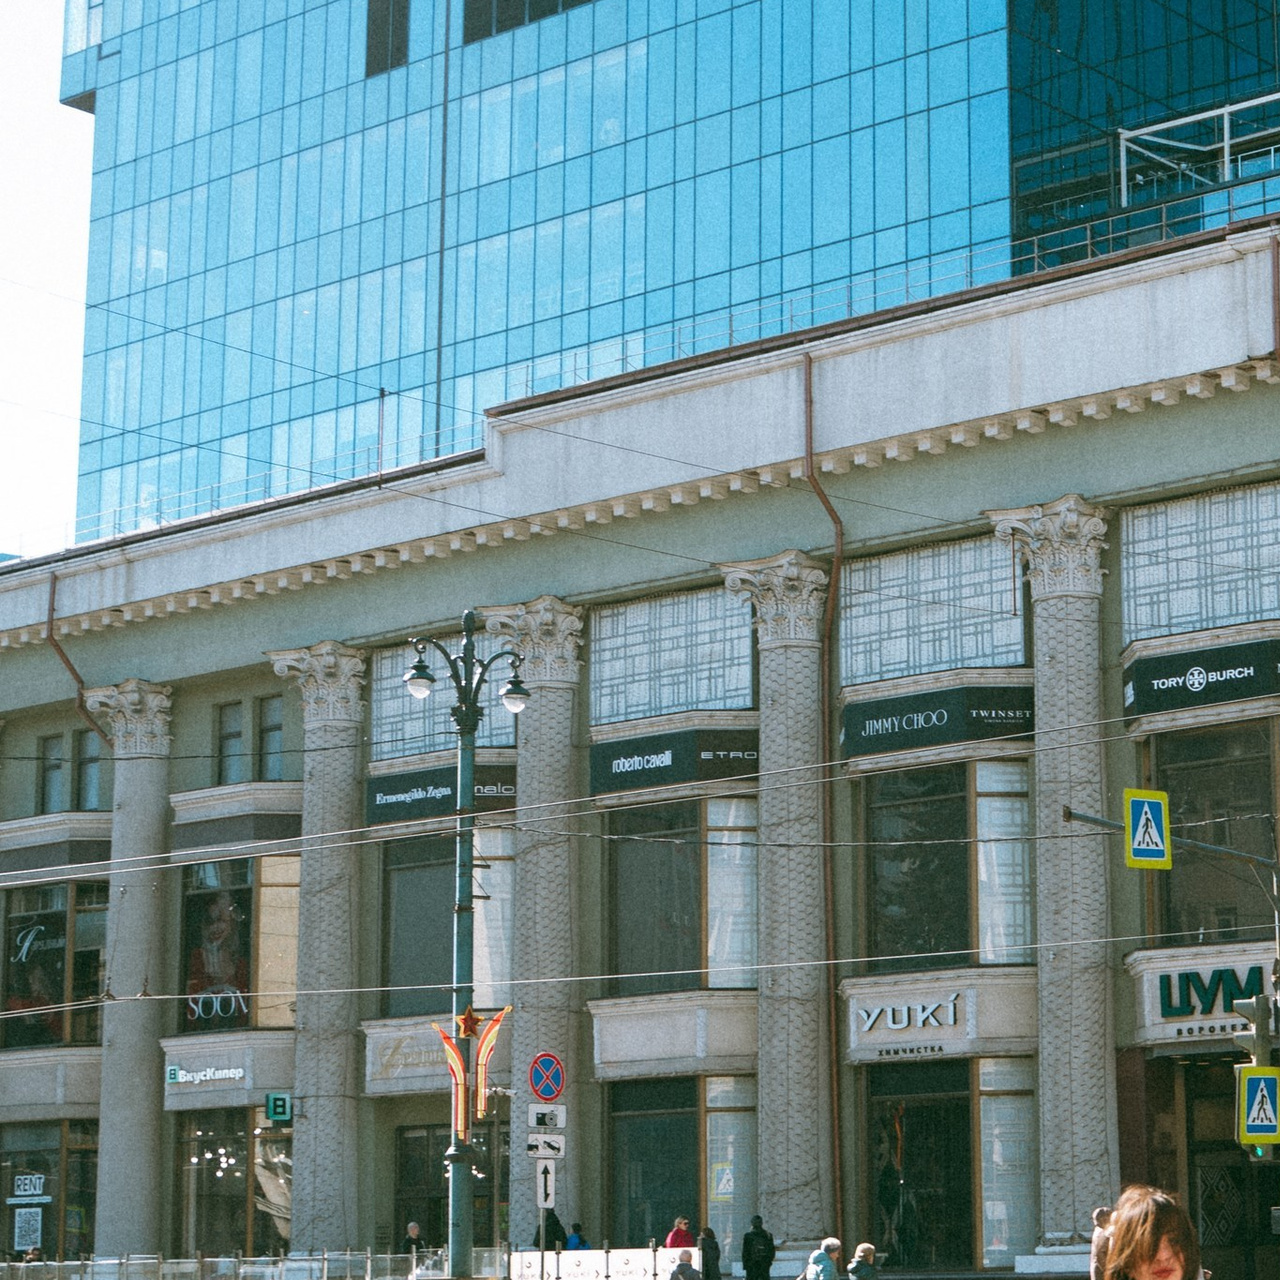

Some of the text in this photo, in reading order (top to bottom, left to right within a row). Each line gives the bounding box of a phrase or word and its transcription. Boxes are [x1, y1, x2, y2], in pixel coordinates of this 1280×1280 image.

[1151, 666, 1254, 690] TORY BURCH
[970, 710, 1032, 718] TWINSET
[861, 715, 901, 737] JIMMY
[902, 709, 948, 730] CHOO
[612, 750, 672, 773] roberto cavalli
[701, 751, 757, 759] ETRO
[375, 785, 452, 805] Ermenegildo Zegna
[1159, 965, 1264, 1018] ЦУМ
[1176, 1022, 1251, 1036] ВОРОНЕЖ
[877, 1045, 944, 1057] ХИМЧИСТКА
[179, 1067, 244, 1084] ВкусКипер
[15, 1176, 44, 1193] RENT
